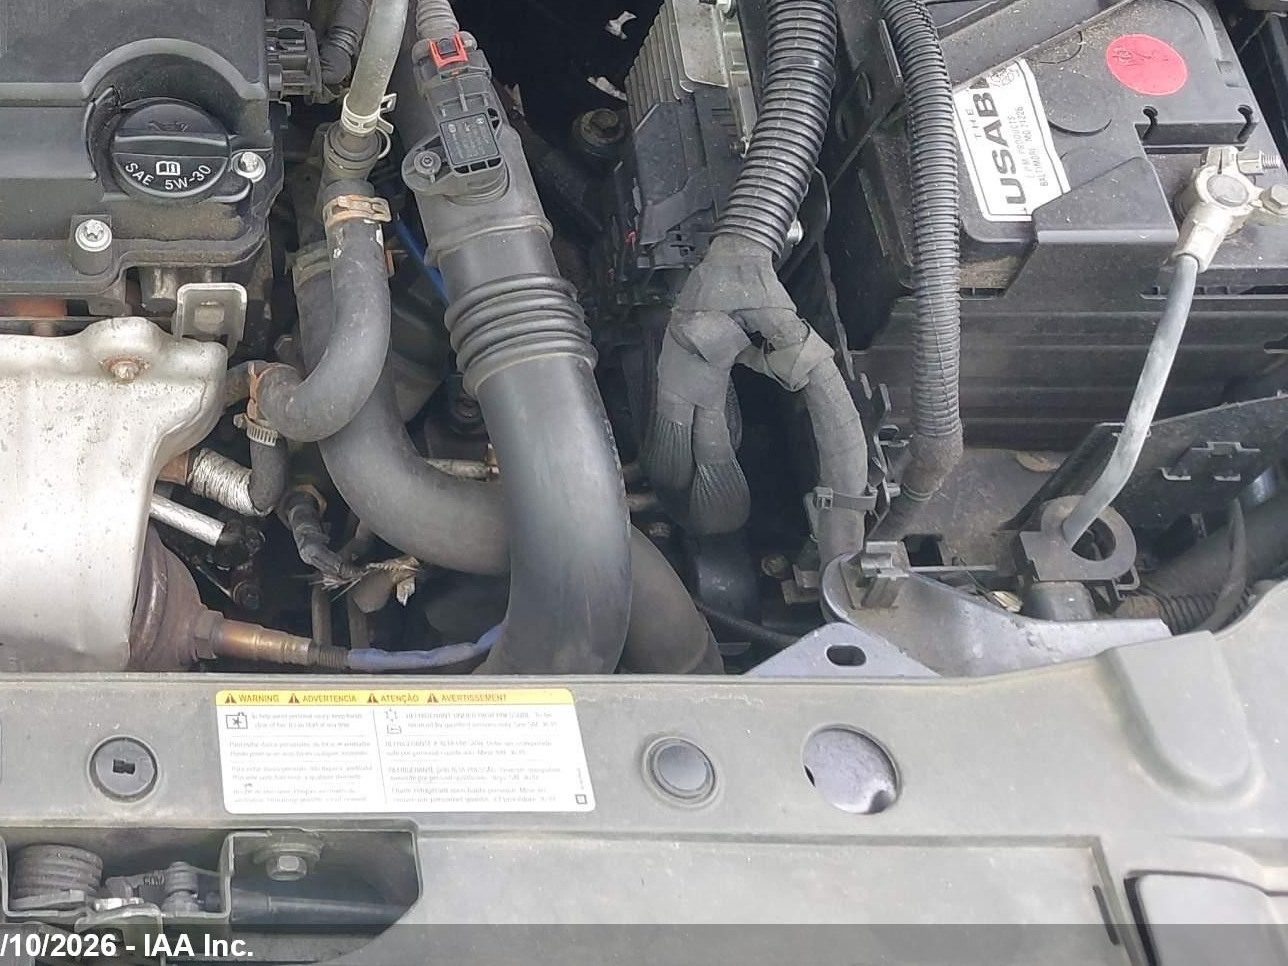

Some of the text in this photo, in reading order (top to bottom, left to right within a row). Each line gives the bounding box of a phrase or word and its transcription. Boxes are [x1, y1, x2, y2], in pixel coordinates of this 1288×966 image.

[966, 108, 982, 138] THE
[125, 162, 212, 190] SAE 5W-30
[238, 694, 507, 704] WARNING ADVERTENCIA ATENÇÃO AVERTISSEMENT
